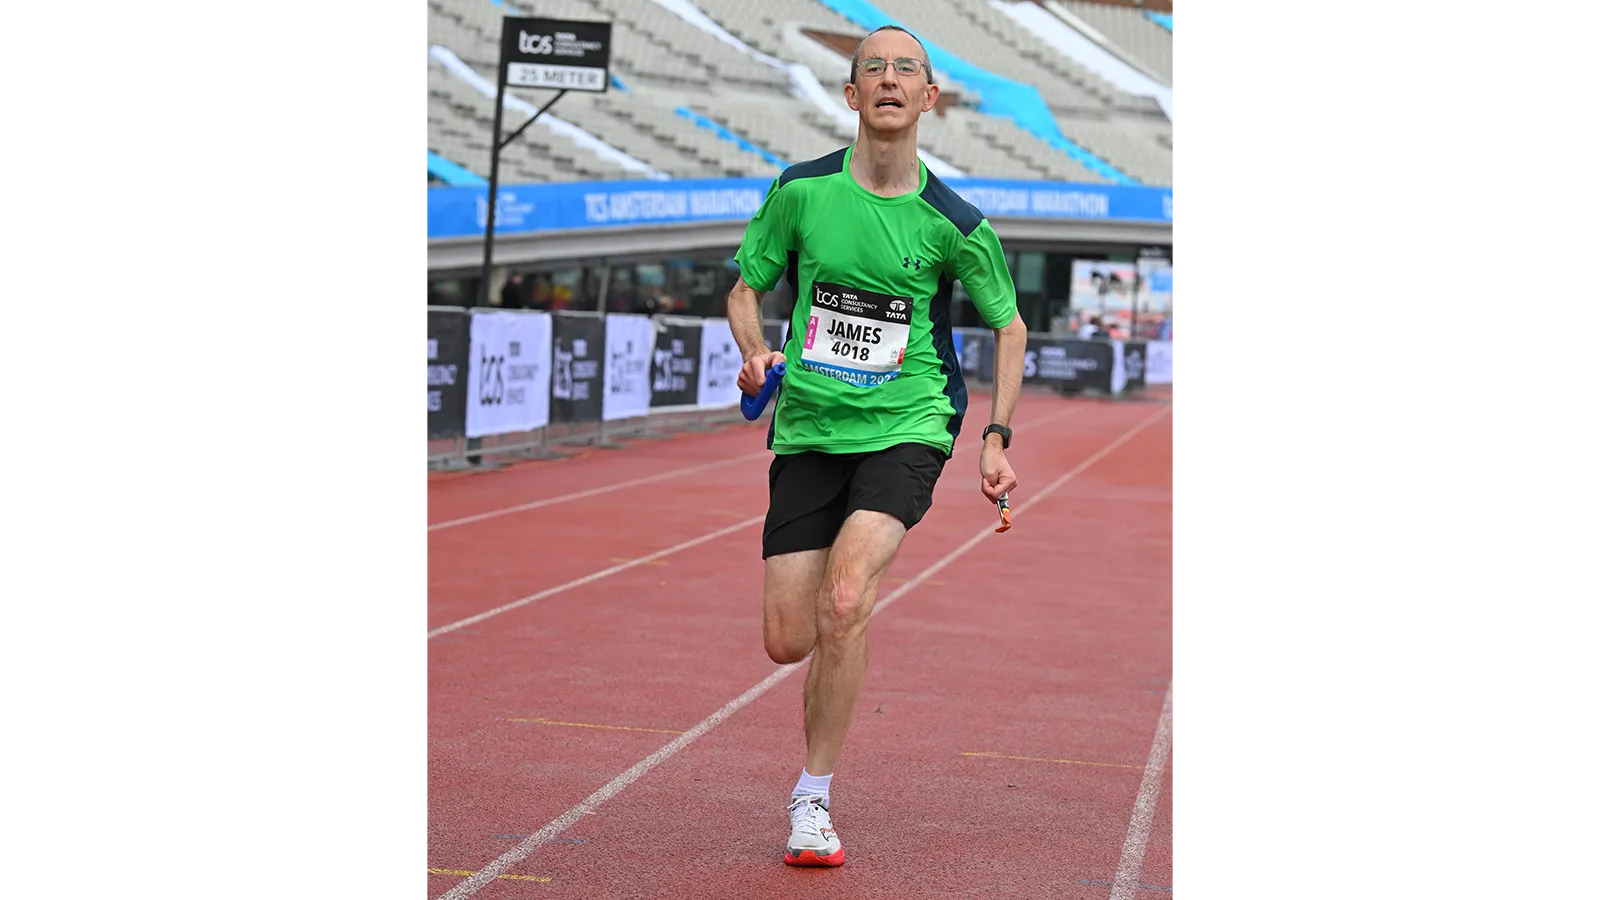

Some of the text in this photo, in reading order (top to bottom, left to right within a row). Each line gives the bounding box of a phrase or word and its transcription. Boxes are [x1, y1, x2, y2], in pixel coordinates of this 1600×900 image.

[519, 66, 599, 86] 25 METER
[842, 293, 858, 301] TATA
[840, 298, 878, 311] CONSULTANCY
[840, 304, 864, 314] SERVICES
[885, 311, 907, 321] TATA
[827, 318, 882, 345] JAMES
[831, 340, 870, 361] 4018
